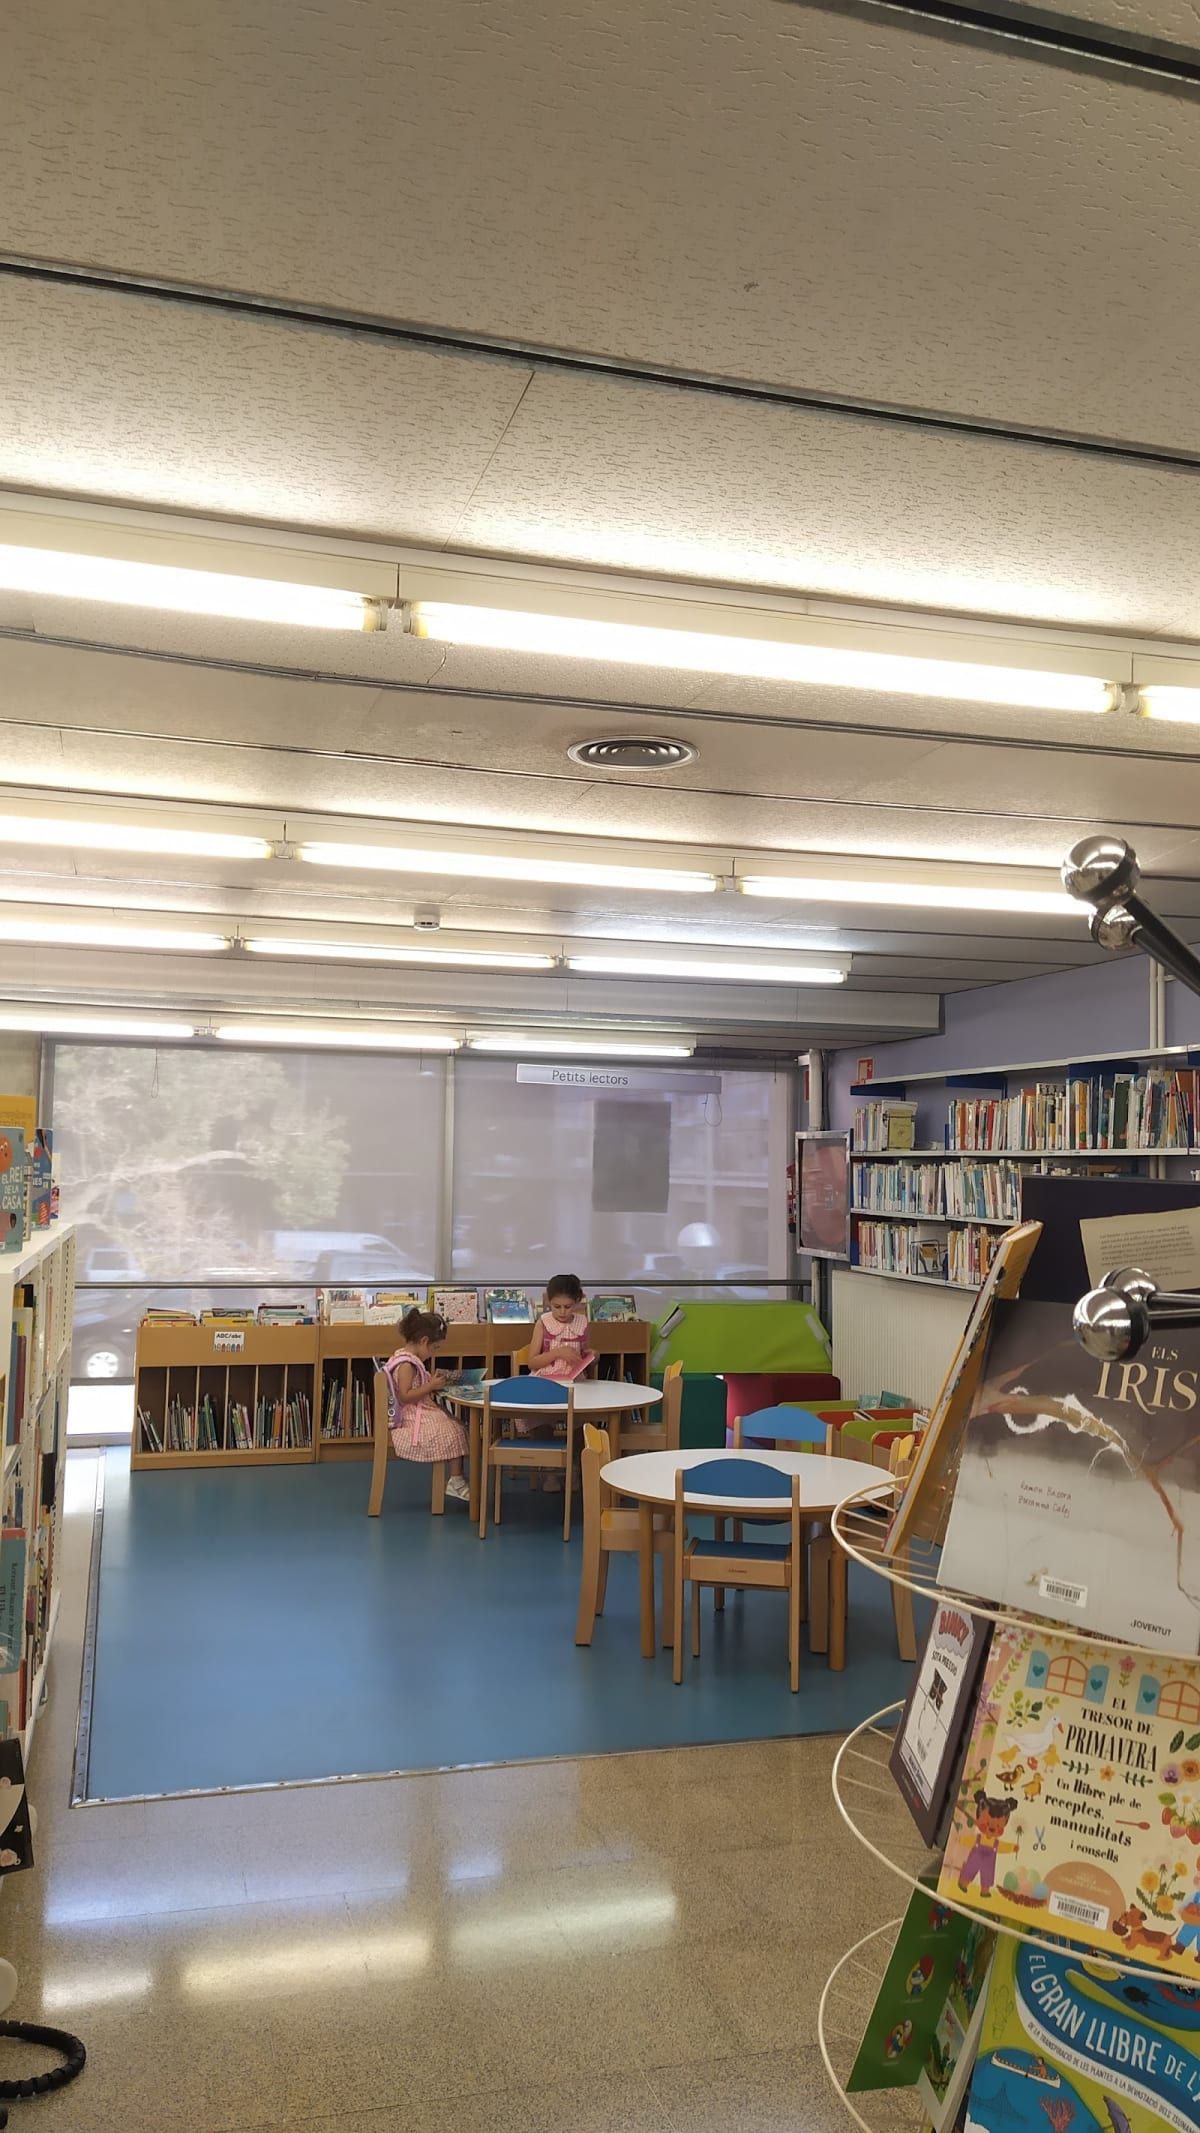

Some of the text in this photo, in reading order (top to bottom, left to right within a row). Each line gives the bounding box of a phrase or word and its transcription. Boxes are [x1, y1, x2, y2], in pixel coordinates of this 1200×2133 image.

[552, 1069, 629, 1085] Petits lectors
[3, 1196, 22, 1209] CASA
[1151, 1346, 1179, 1360] ELS
[1092, 1360, 1199, 1415] IRIS
[1131, 1619, 1172, 1637] JOVENTUT
[1112, 1697, 1128, 1711] EL
[1081, 1707, 1155, 1736] TRESOR DE
[1065, 1724, 1157, 1772] PRIMAVERA
[1056, 1777, 1142, 1809] Un llibre ple de
[1050, 1815, 1132, 1847] manualitats
[1076, 1844, 1119, 1863] consells
[1029, 1954, 1047, 1974] EL
[1031, 1973, 1086, 2039] GRAN
[1085, 2017, 1162, 2075] LLIBRE
[1080, 2061, 1089, 2071] LES
[1090, 2064, 1113, 2082] PLANTES
[1164, 2054, 1187, 2081] DE
